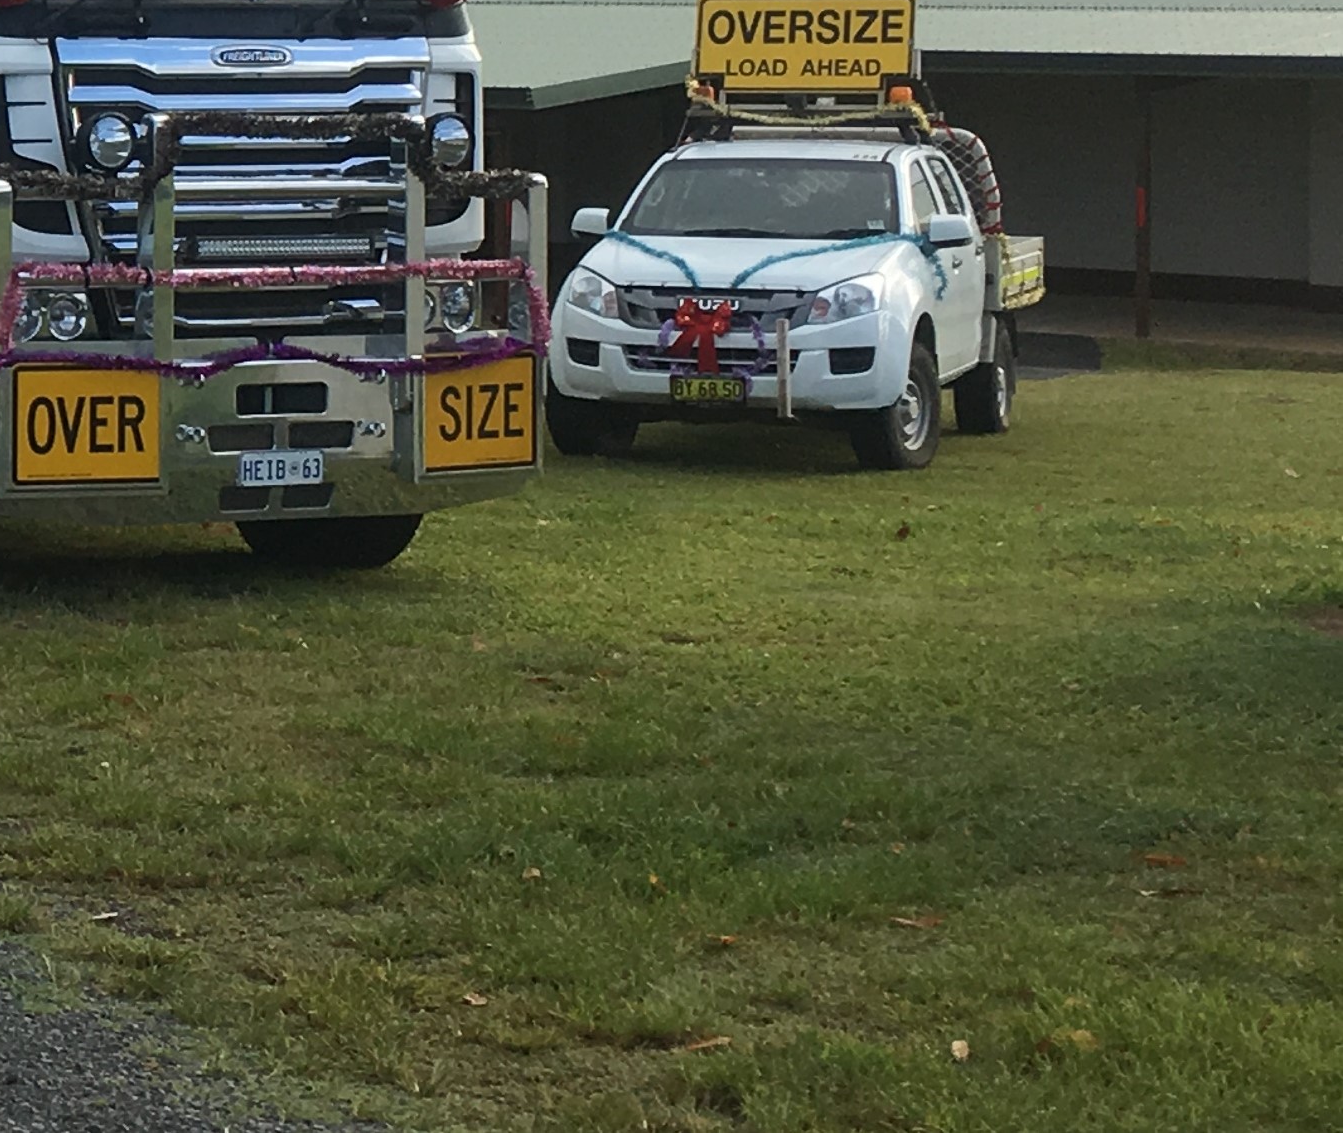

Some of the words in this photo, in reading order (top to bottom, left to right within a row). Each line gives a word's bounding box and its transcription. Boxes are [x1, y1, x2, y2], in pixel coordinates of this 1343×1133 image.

[708, 9, 905, 45] OVERSIZE
[725, 58, 788, 77] LOAD
[800, 58, 881, 77] AHEAD
[26, 394, 146, 455] OVER
[438, 382, 525, 443] SIZE
